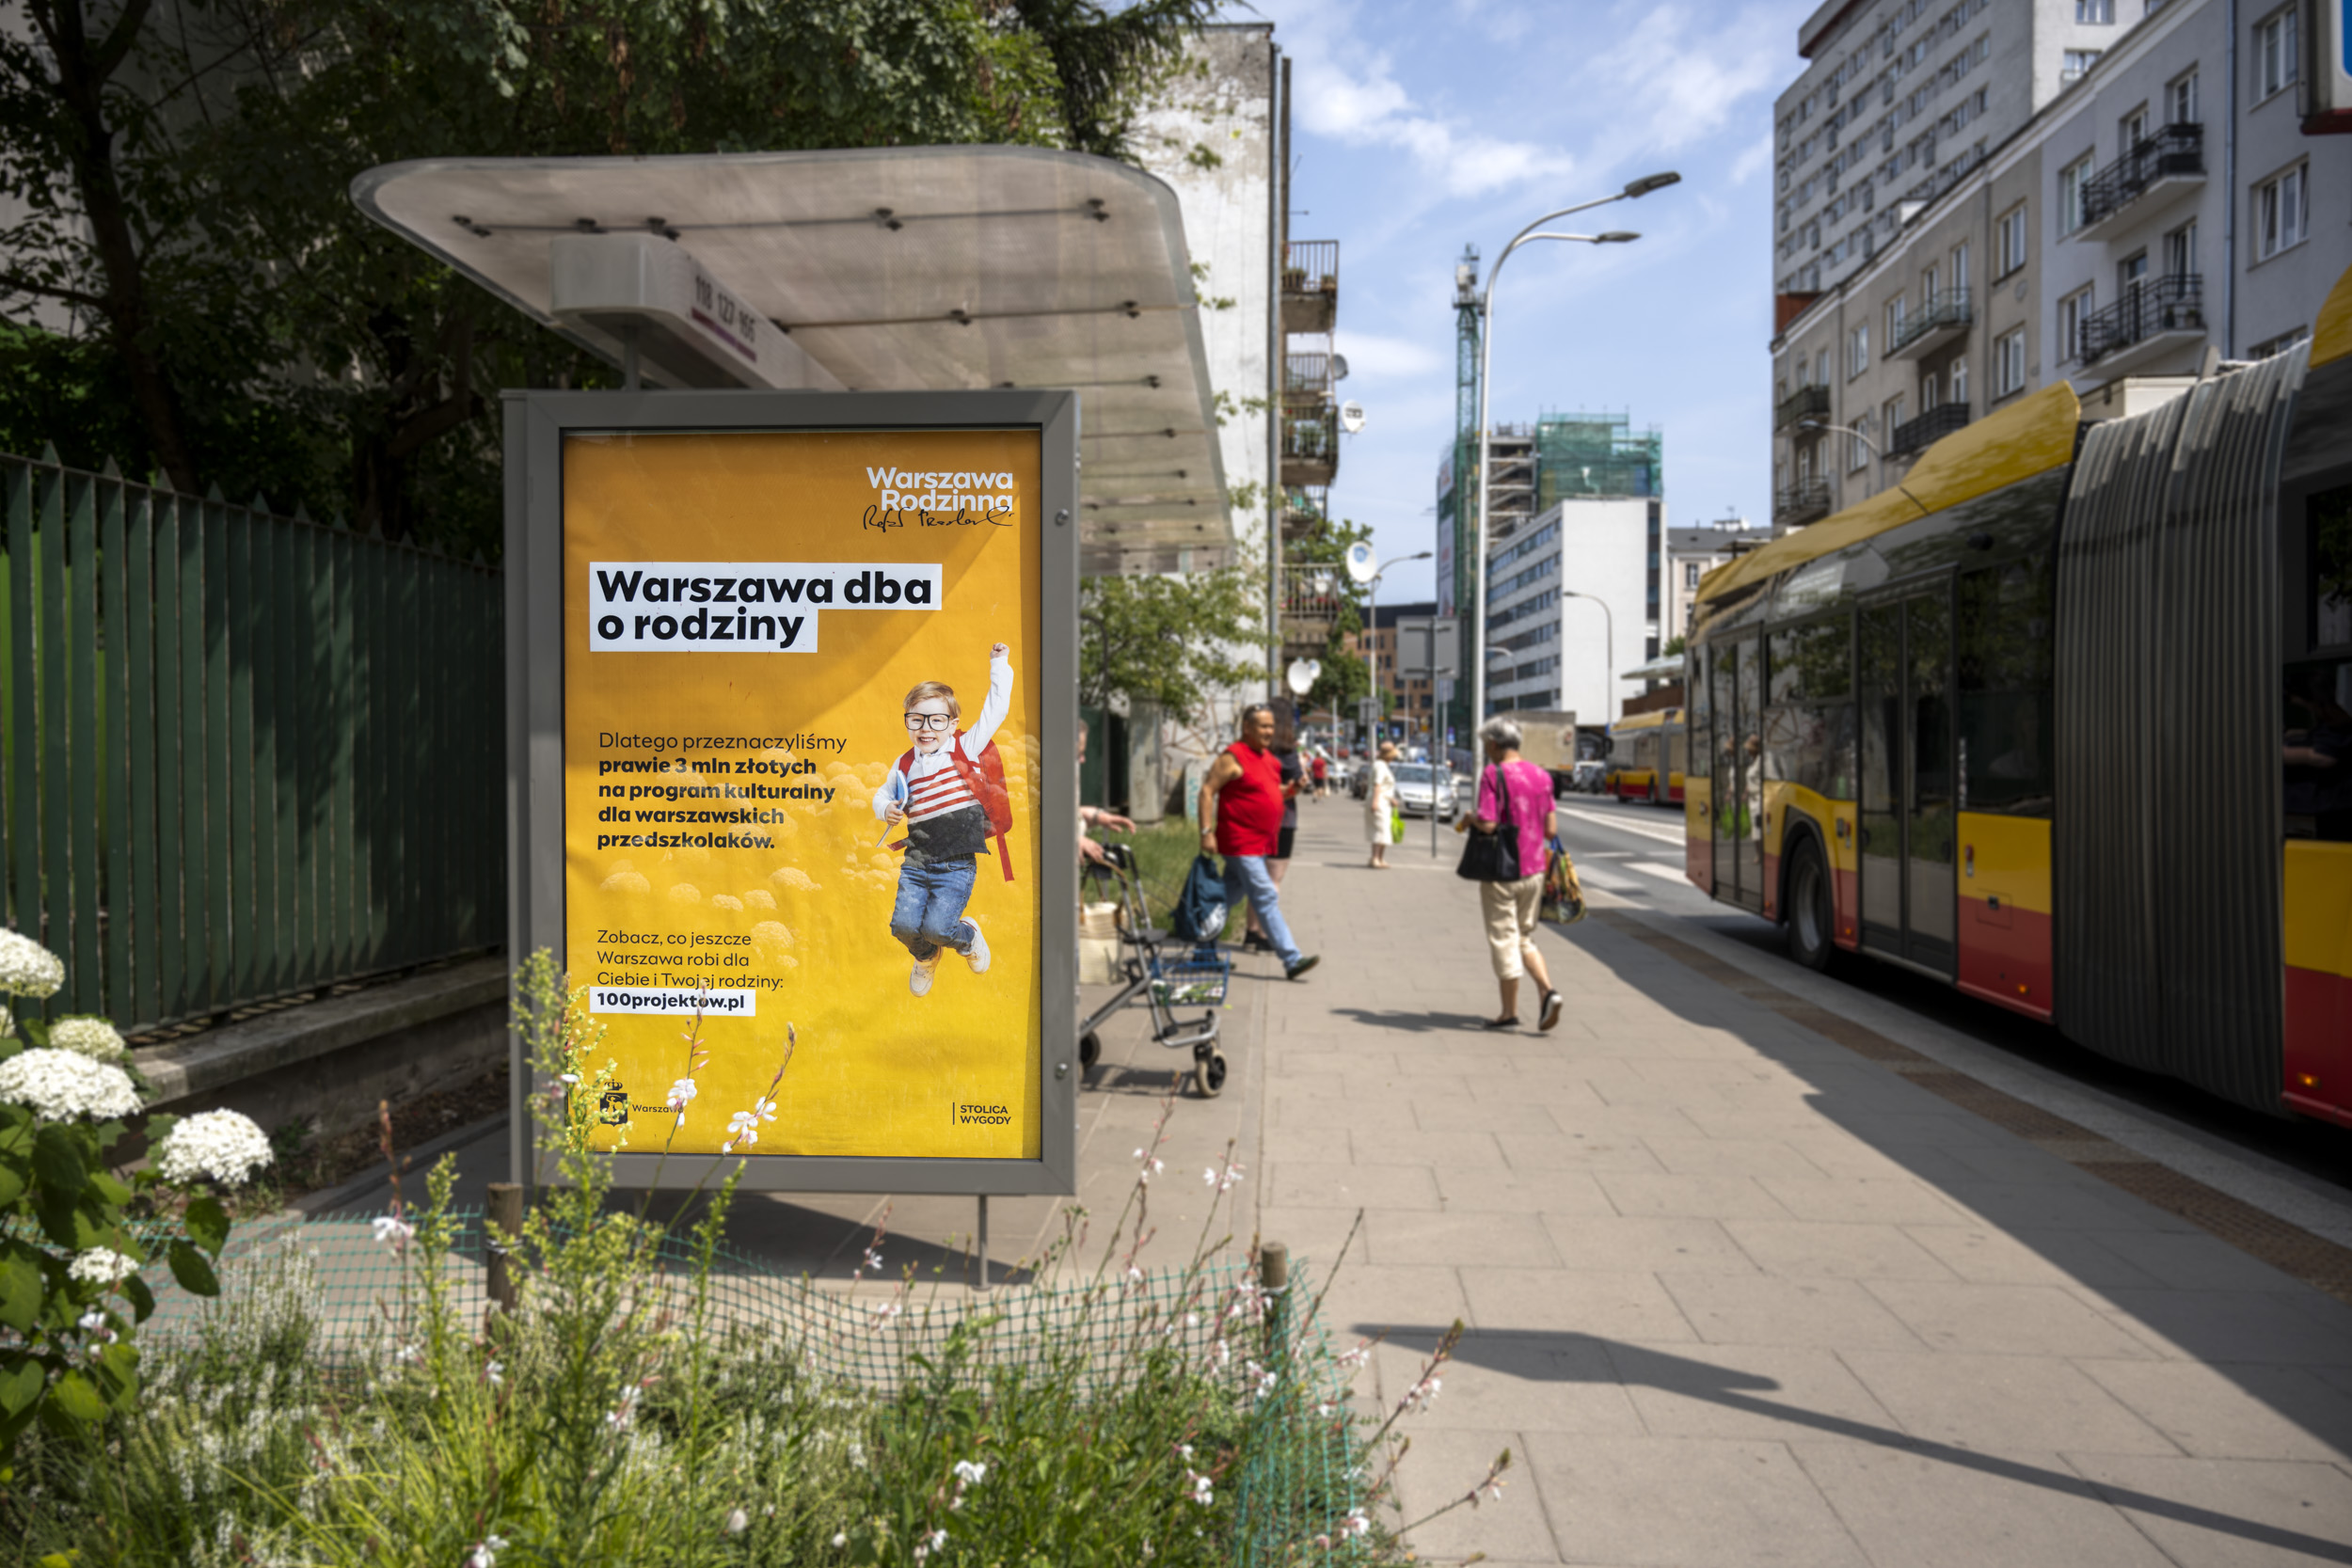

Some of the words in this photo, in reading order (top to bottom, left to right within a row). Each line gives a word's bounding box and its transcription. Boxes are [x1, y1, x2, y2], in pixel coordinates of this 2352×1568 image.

[866, 467, 1013, 489] Warszawa
[881, 489, 1013, 512] Rodzinna
[596, 570, 833, 603] Warszawa
[844, 571, 931, 604] dba
[597, 614, 624, 640] o
[635, 608, 804, 649] rodziny
[599, 732, 678, 752] Dlatego
[683, 733, 847, 753] przeznaczyliśmy
[599, 757, 670, 776] prawie
[675, 757, 687, 773] 3
[691, 758, 730, 774] mln
[735, 758, 817, 778] złotych
[598, 784, 624, 798] na
[629, 784, 720, 800] program
[724, 783, 835, 803] kulturalny
[598, 806, 630, 822] dla
[635, 807, 785, 824] warszawskich
[597, 831, 775, 850] przedszkolaków.
[597, 929, 663, 946] Zobacz,
[667, 934, 687, 944] co
[690, 932, 752, 948] jeszcze
[597, 951, 683, 965] Warszawa
[688, 953, 719, 966] robi
[723, 953, 749, 967] dla
[597, 972, 649, 986] Ciebie
[654, 973, 658, 986] i
[661, 973, 714, 990] Twojej
[719, 974, 784, 991] rodziny:
[596, 992, 744, 1011] 100projektow.pl
[632, 1104, 683, 1114] Warszawa
[961, 1104, 1008, 1114] STOLICA
[961, 1116, 1011, 1124] WYGODY
